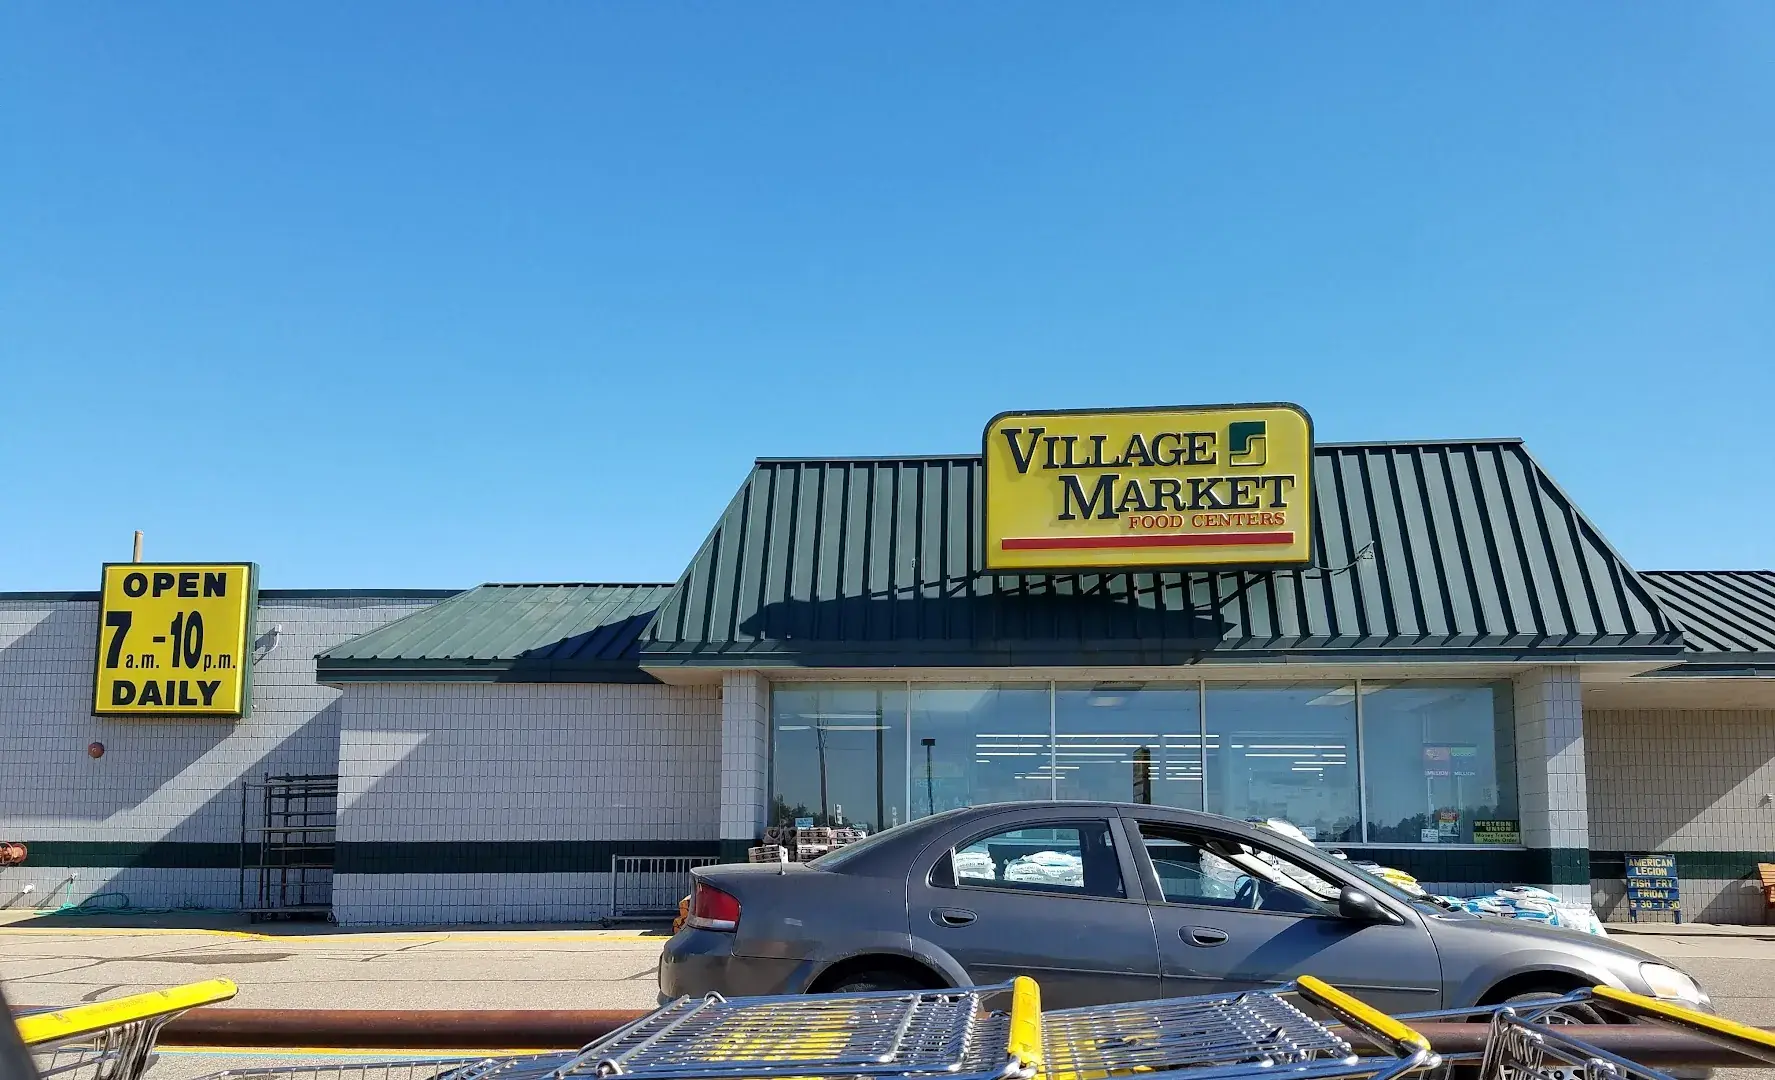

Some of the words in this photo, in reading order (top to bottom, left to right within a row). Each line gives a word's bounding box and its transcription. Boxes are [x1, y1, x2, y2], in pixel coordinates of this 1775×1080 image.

[1001, 427, 1218, 474] VILLAGE
[1058, 474, 1295, 521] MARKET
[1128, 515, 1184, 530] FOOD
[1191, 511, 1285, 528] CENTERS
[123, 572, 227, 598] OPEN
[105, 610, 133, 669] 7
[125, 654, 160, 669] a.m.
[203, 653, 236, 672] p.m.
[111, 680, 222, 706] DAILY
[1628, 859, 1673, 867] AMERICAN
[1635, 866, 1667, 876] LEGION
[1630, 879, 1651, 888] FISH
[1655, 878, 1673, 888] FRY
[1637, 889, 1669, 898] FRIDAY
